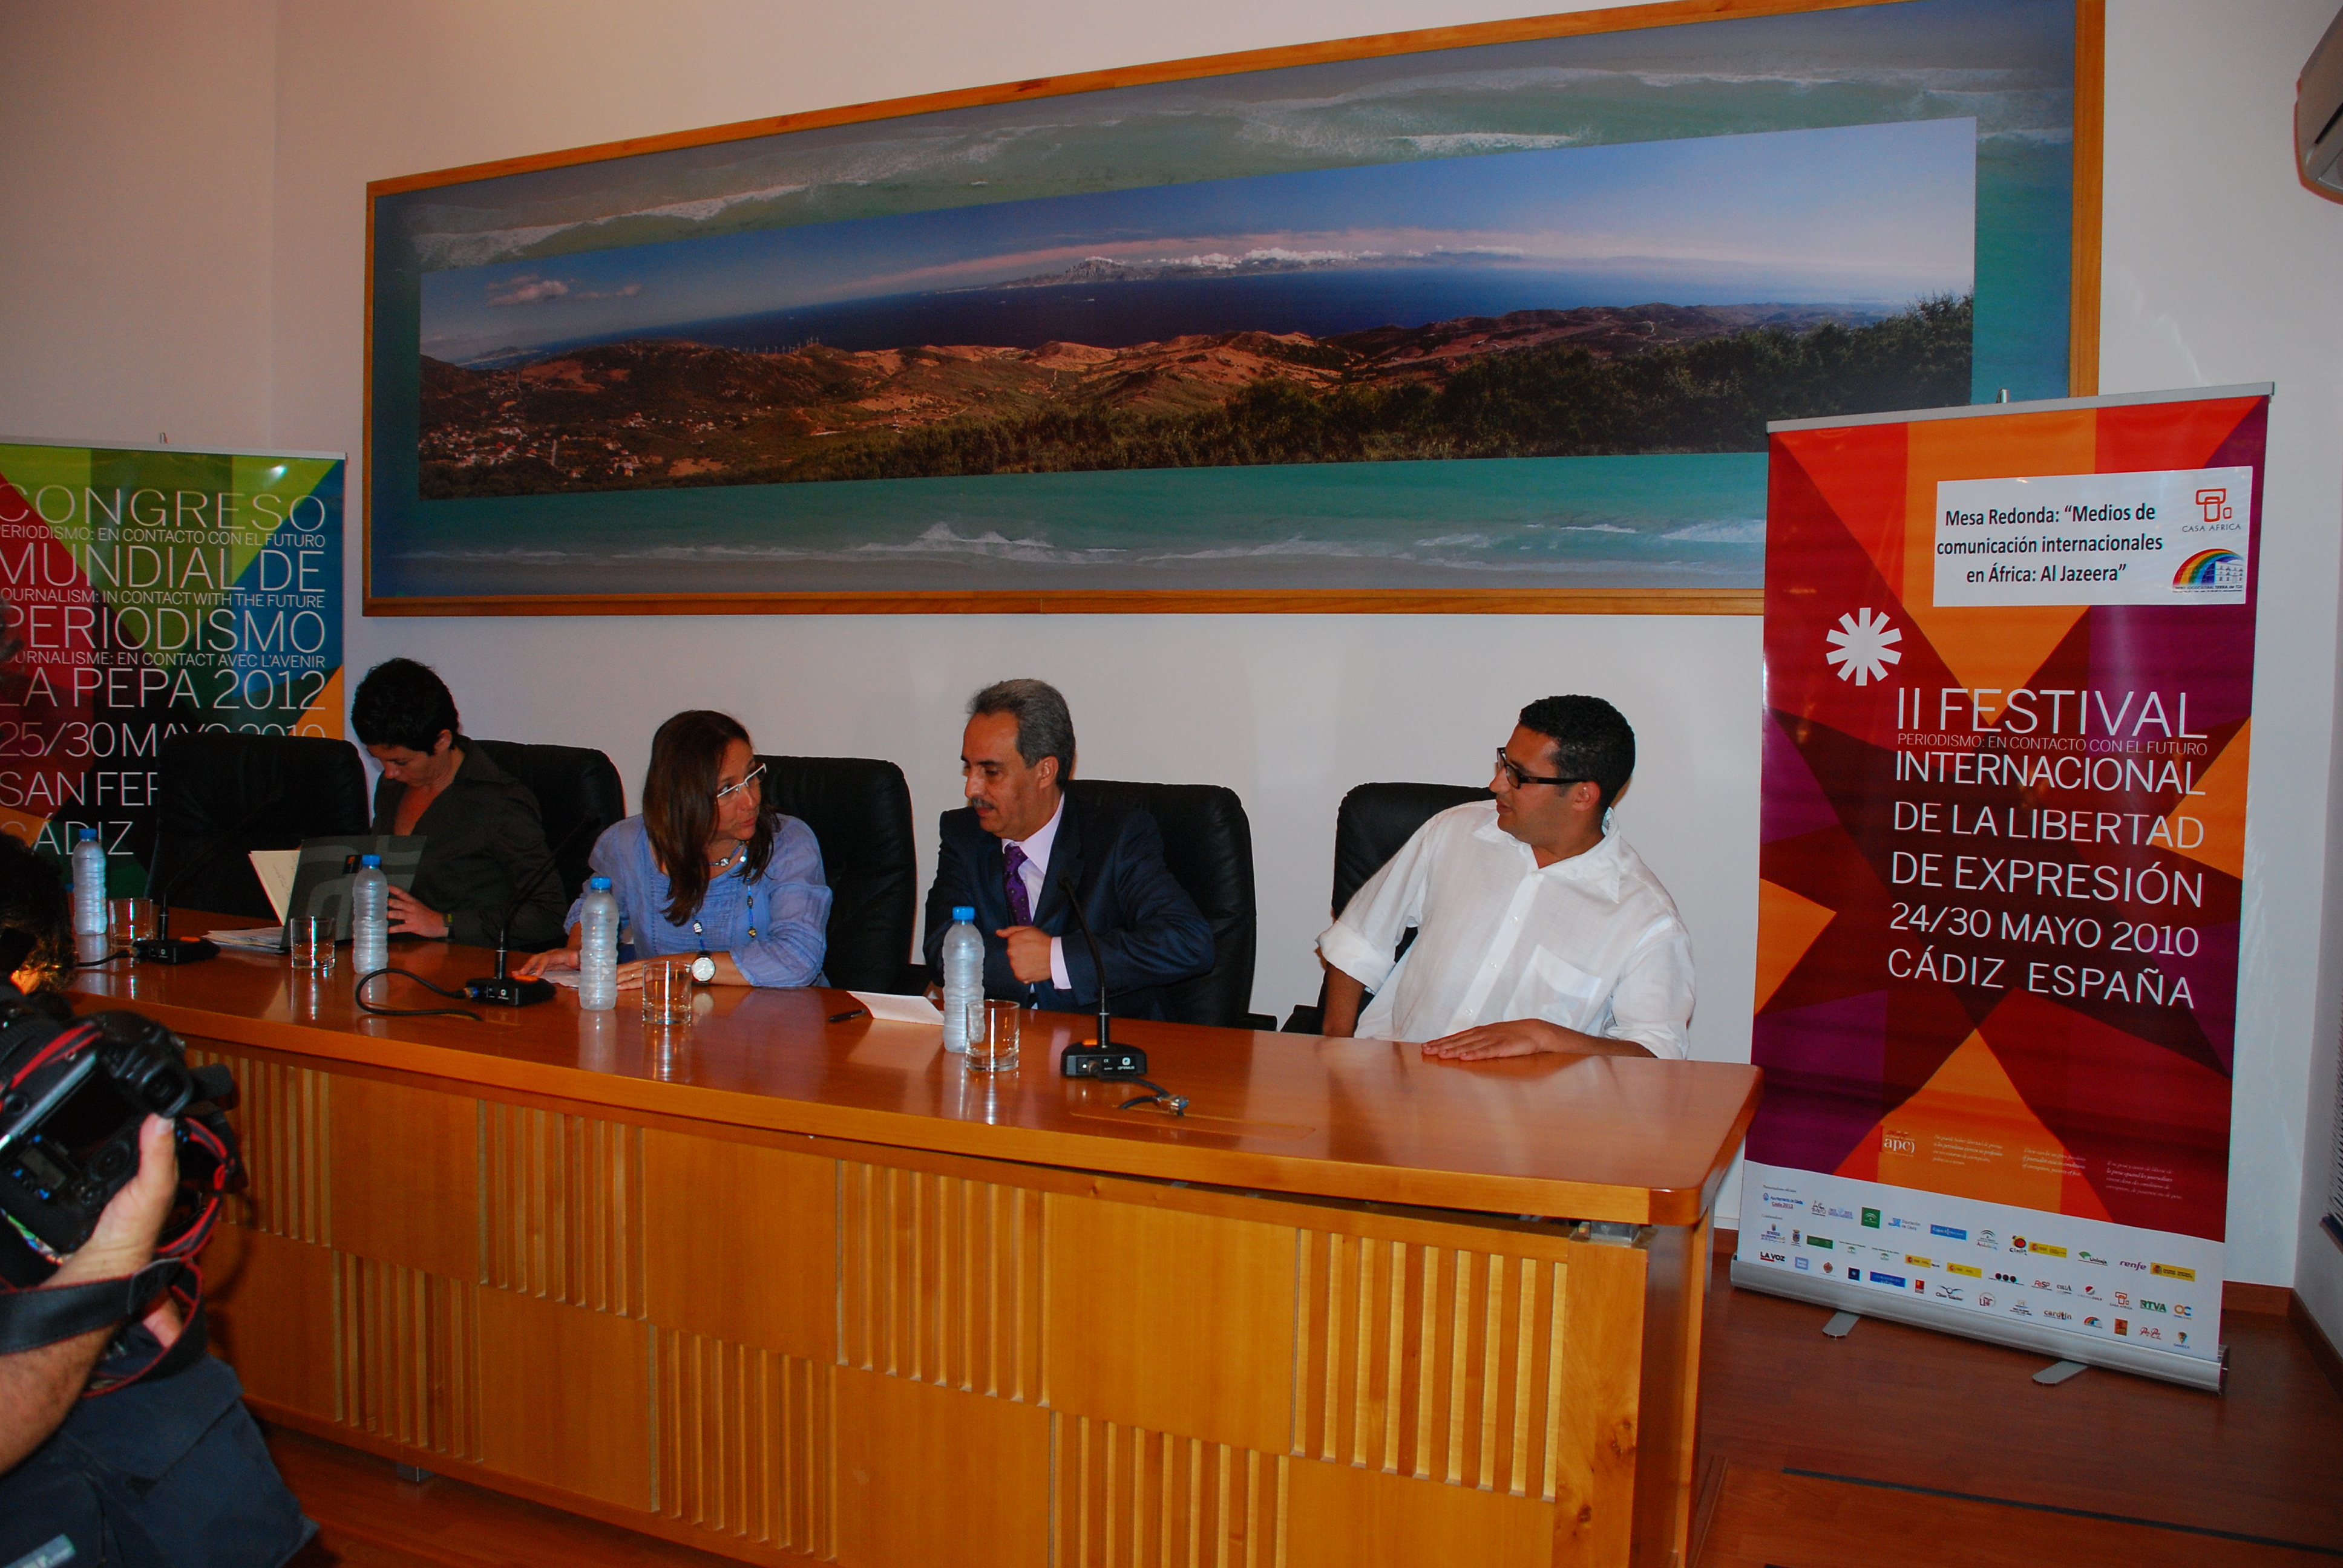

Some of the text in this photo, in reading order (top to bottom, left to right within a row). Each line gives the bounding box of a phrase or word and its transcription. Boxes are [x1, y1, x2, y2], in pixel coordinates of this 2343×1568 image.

[0, 483, 326, 532] CONGRESO
[1945, 509, 1984, 527] Mesa
[1988, 506, 2059, 526] Redonda:
[2135, 503, 2156, 521] de
[0, 524, 326, 548] ERIODISMO: EN CONTACTO CON EL FUTURO
[2181, 523, 2241, 533] CASA AFRICA
[1936, 534, 2163, 555] comunicación internacionales
[0, 542, 326, 592] MUNDIAL DE
[1966, 570, 1985, 583] en
[1988, 563, 2037, 583] África:
[2040, 564, 2057, 582] Al
[0, 587, 326, 609] OURNALISM: IN CONTACT WITH THE FUTURE
[5, 650, 114, 665] URNALISME:
[117, 652, 138, 665] EN
[142, 653, 215, 666] CONTACT
[218, 654, 258, 667] AVEC
[74, 667, 200, 708] PEPA
[214, 668, 326, 710] 2012
[1898, 687, 2207, 739] II FESTIVAL
[0, 721, 115, 757] 25/30
[1898, 733, 2207, 756] PERIODISMO: EN CONTACTO CON EL FUTURO
[1896, 750, 2206, 795] INTERNACIONAL
[0, 771, 85, 806] SAN
[1894, 801, 2204, 849] DE LA LIBERTAD
[1892, 851, 2203, 908] DE EXPRESIÓN
[1890, 902, 2199, 958] 24/30 MAYO 2010
[1888, 945, 2195, 1010] CÁDIZ ESPAÑA
[1771, 1253, 1786, 1262] VOZ
[2120, 1260, 2146, 1270] renfe
[2140, 1299, 2166, 1313] RTVA
